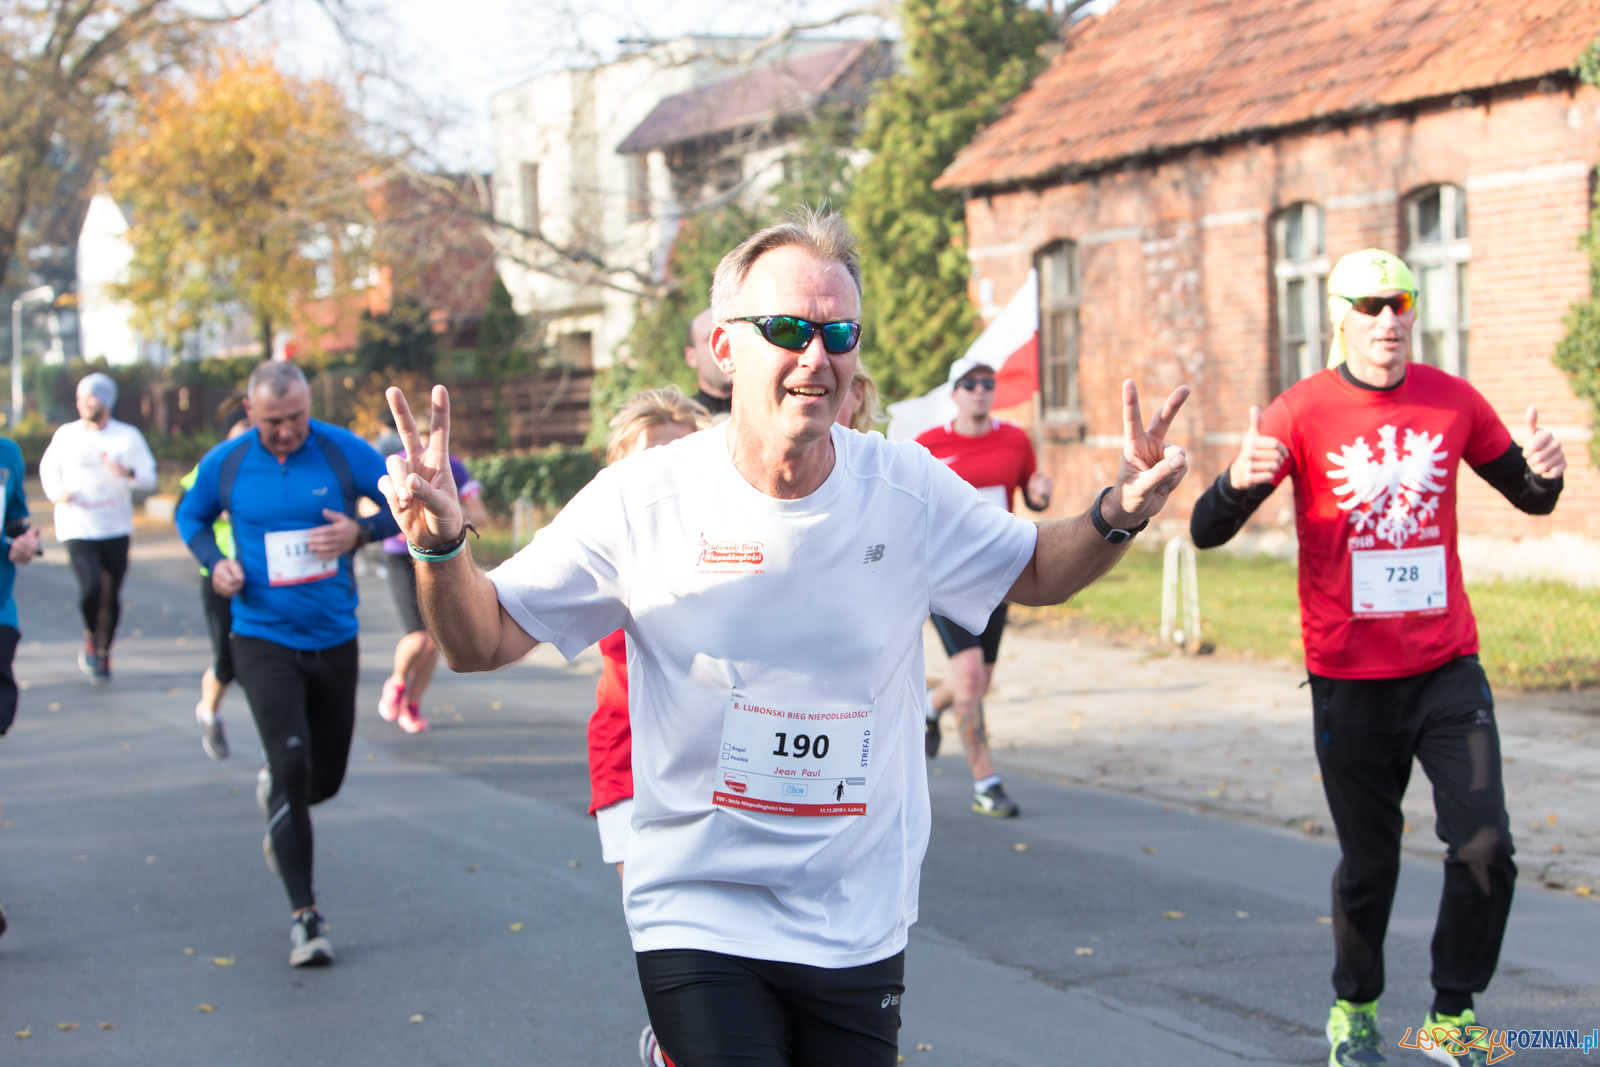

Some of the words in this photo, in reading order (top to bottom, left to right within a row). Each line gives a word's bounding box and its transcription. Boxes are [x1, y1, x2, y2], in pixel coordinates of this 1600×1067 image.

[1385, 564, 1419, 583] 728
[733, 702, 741, 710] 8.
[743, 703, 786, 718] LUBOŃSKI
[787, 711, 806, 720] BIEG
[808, 710, 869, 721] NIEPODLEGŁOŚCI
[864, 729, 871, 737] D
[772, 732, 830, 759] 190
[860, 738, 871, 768] STREFA
[773, 766, 796, 776] Jean
[801, 768, 821, 777] Paul
